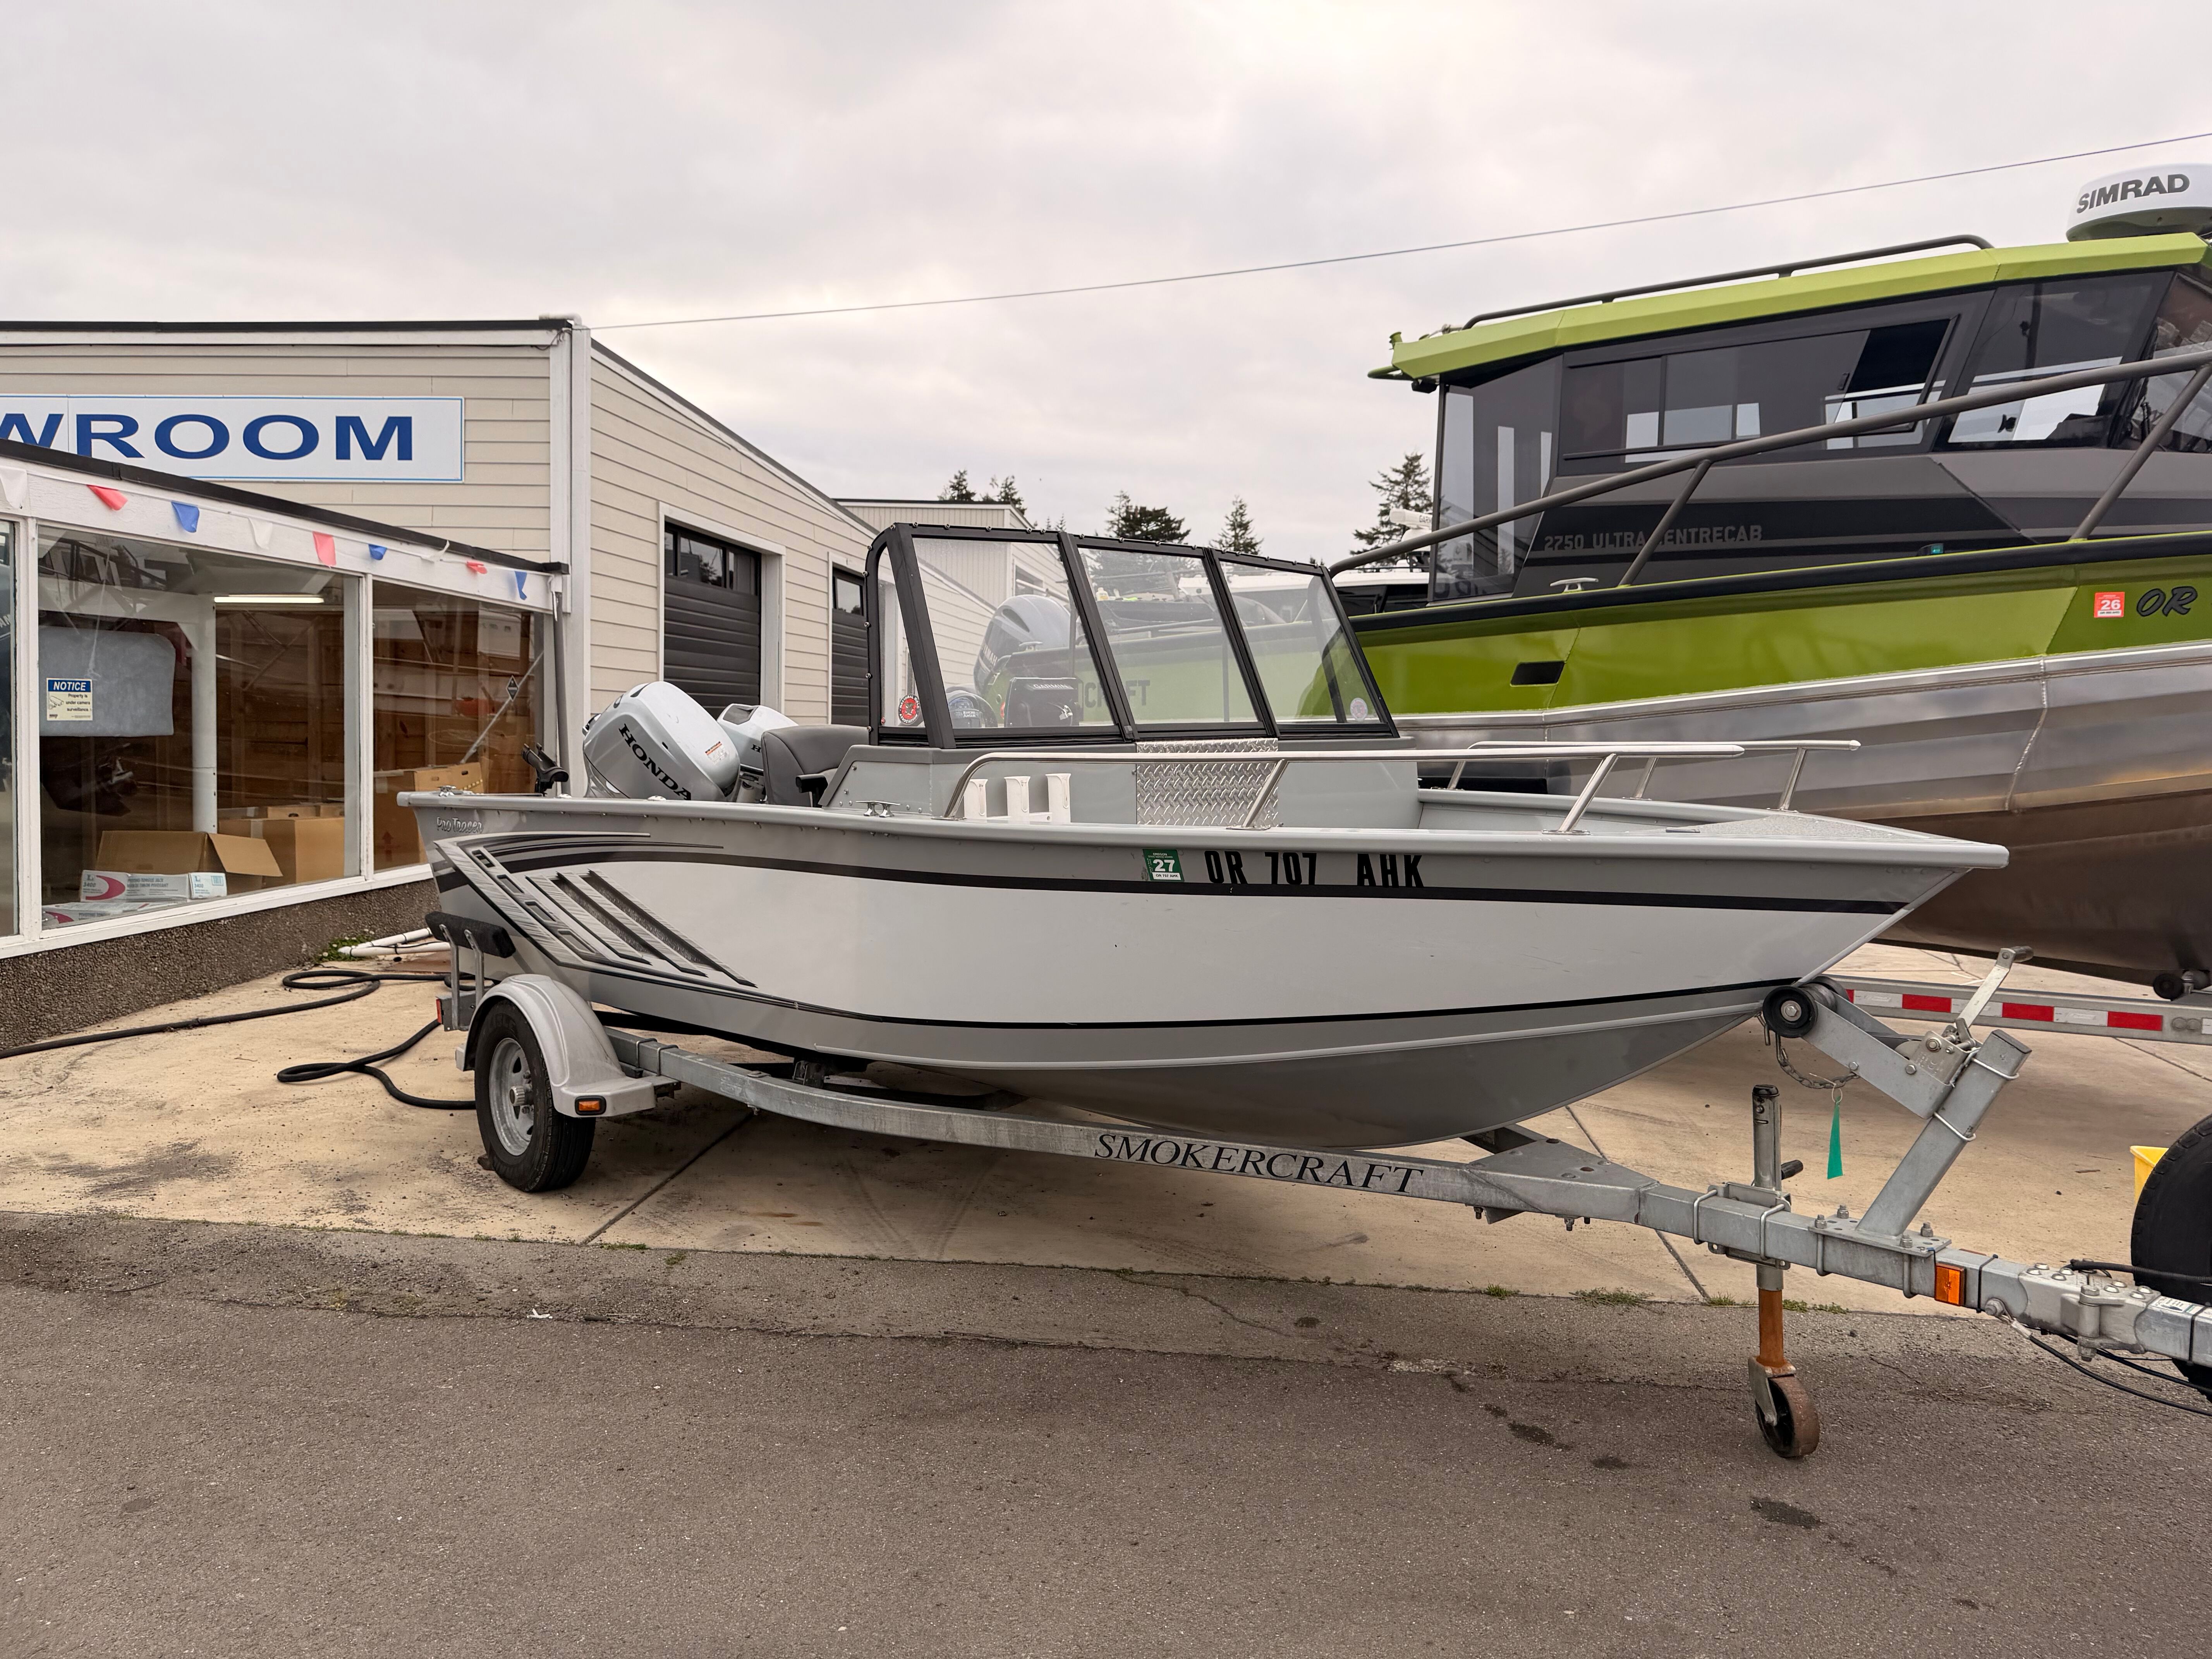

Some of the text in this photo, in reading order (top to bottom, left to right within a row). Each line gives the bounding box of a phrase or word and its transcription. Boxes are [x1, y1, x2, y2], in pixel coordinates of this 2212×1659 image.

[2077, 174, 2190, 213] SIMRAD
[1544, 525, 1762, 551] 2750 ULTRA ENTRECAB
[2101, 599, 2121, 610] 26
[2136, 586, 2198, 617] OR
[53, 681, 86, 691] NOTICE
[618, 723, 691, 800] HONDA
[1153, 859, 1175, 872] 27
[1204, 850, 1424, 888] OR 707 AHK
[1094, 1133, 1424, 1194] SMOKERCRAFT
